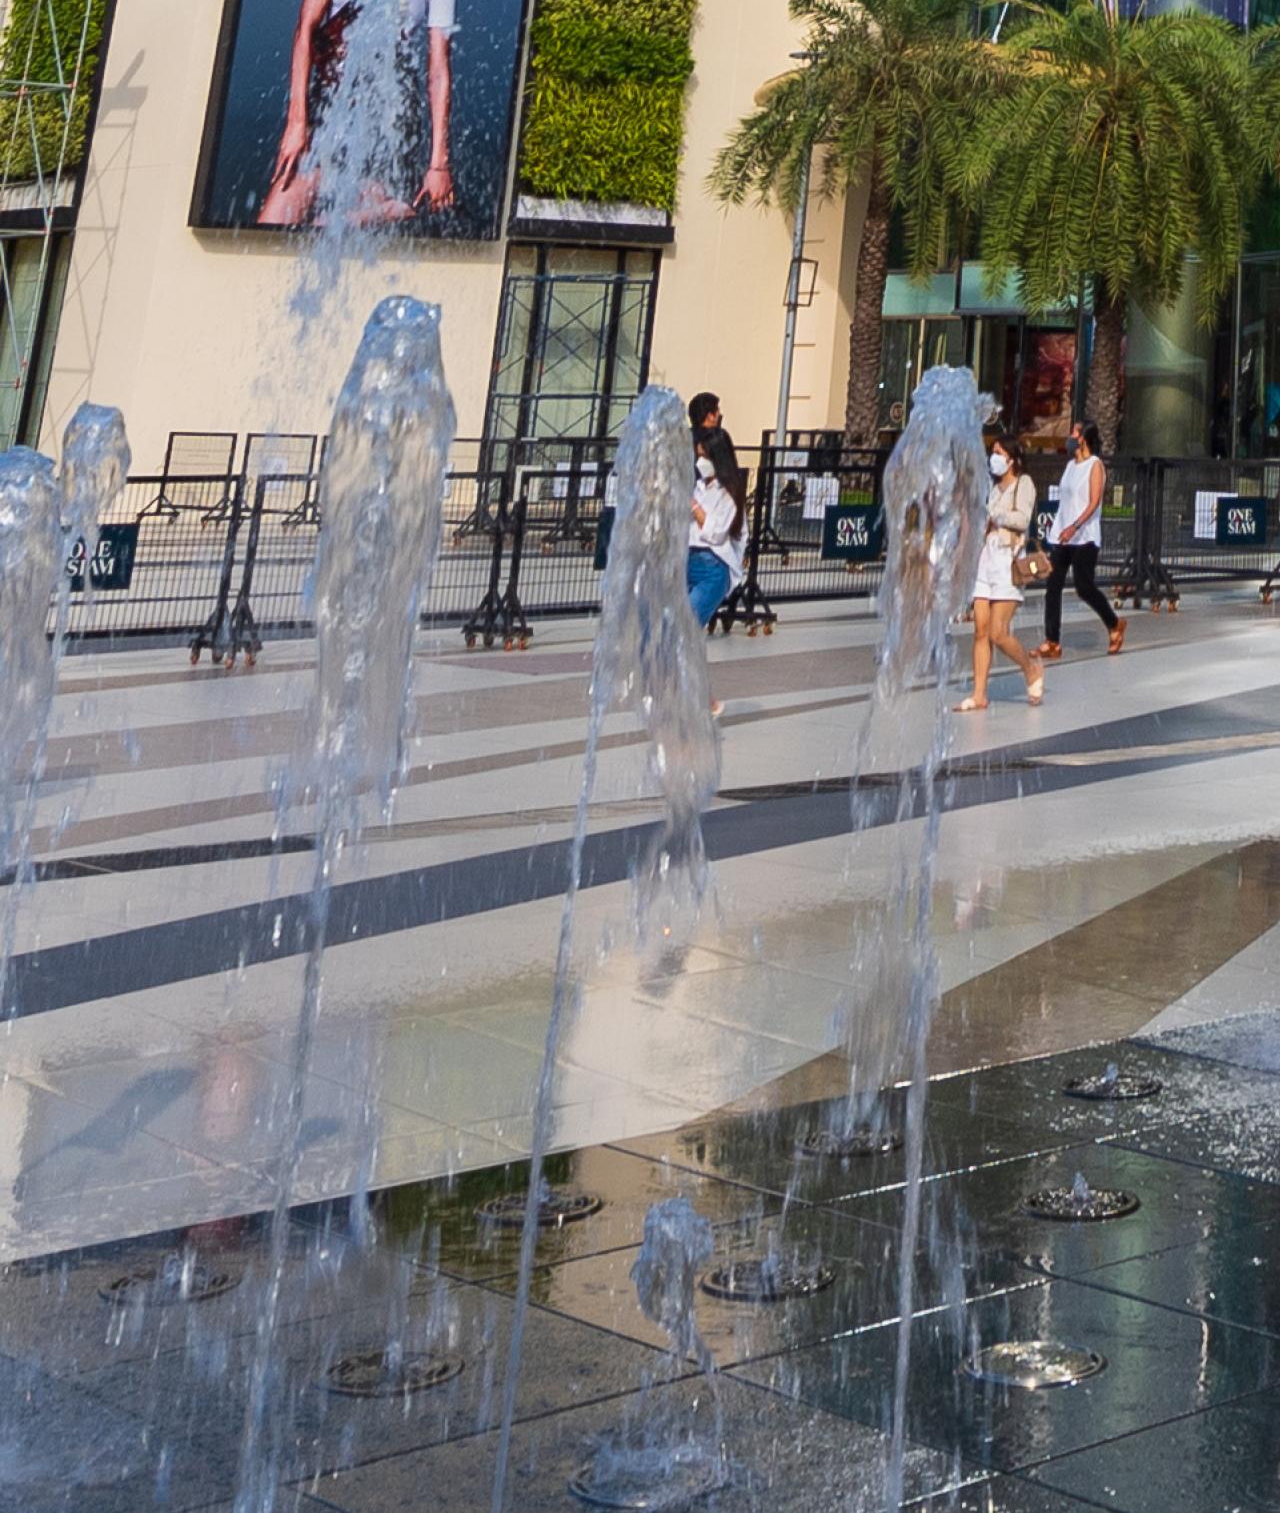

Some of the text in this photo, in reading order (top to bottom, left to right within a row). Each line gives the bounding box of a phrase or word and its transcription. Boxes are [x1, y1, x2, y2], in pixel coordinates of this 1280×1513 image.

[1227, 508, 1253, 522] ONE
[837, 515, 867, 532] ONE
[1227, 521, 1257, 535] SIAM
[836, 531, 869, 547] SIAM
[71, 540, 112, 559] OE
